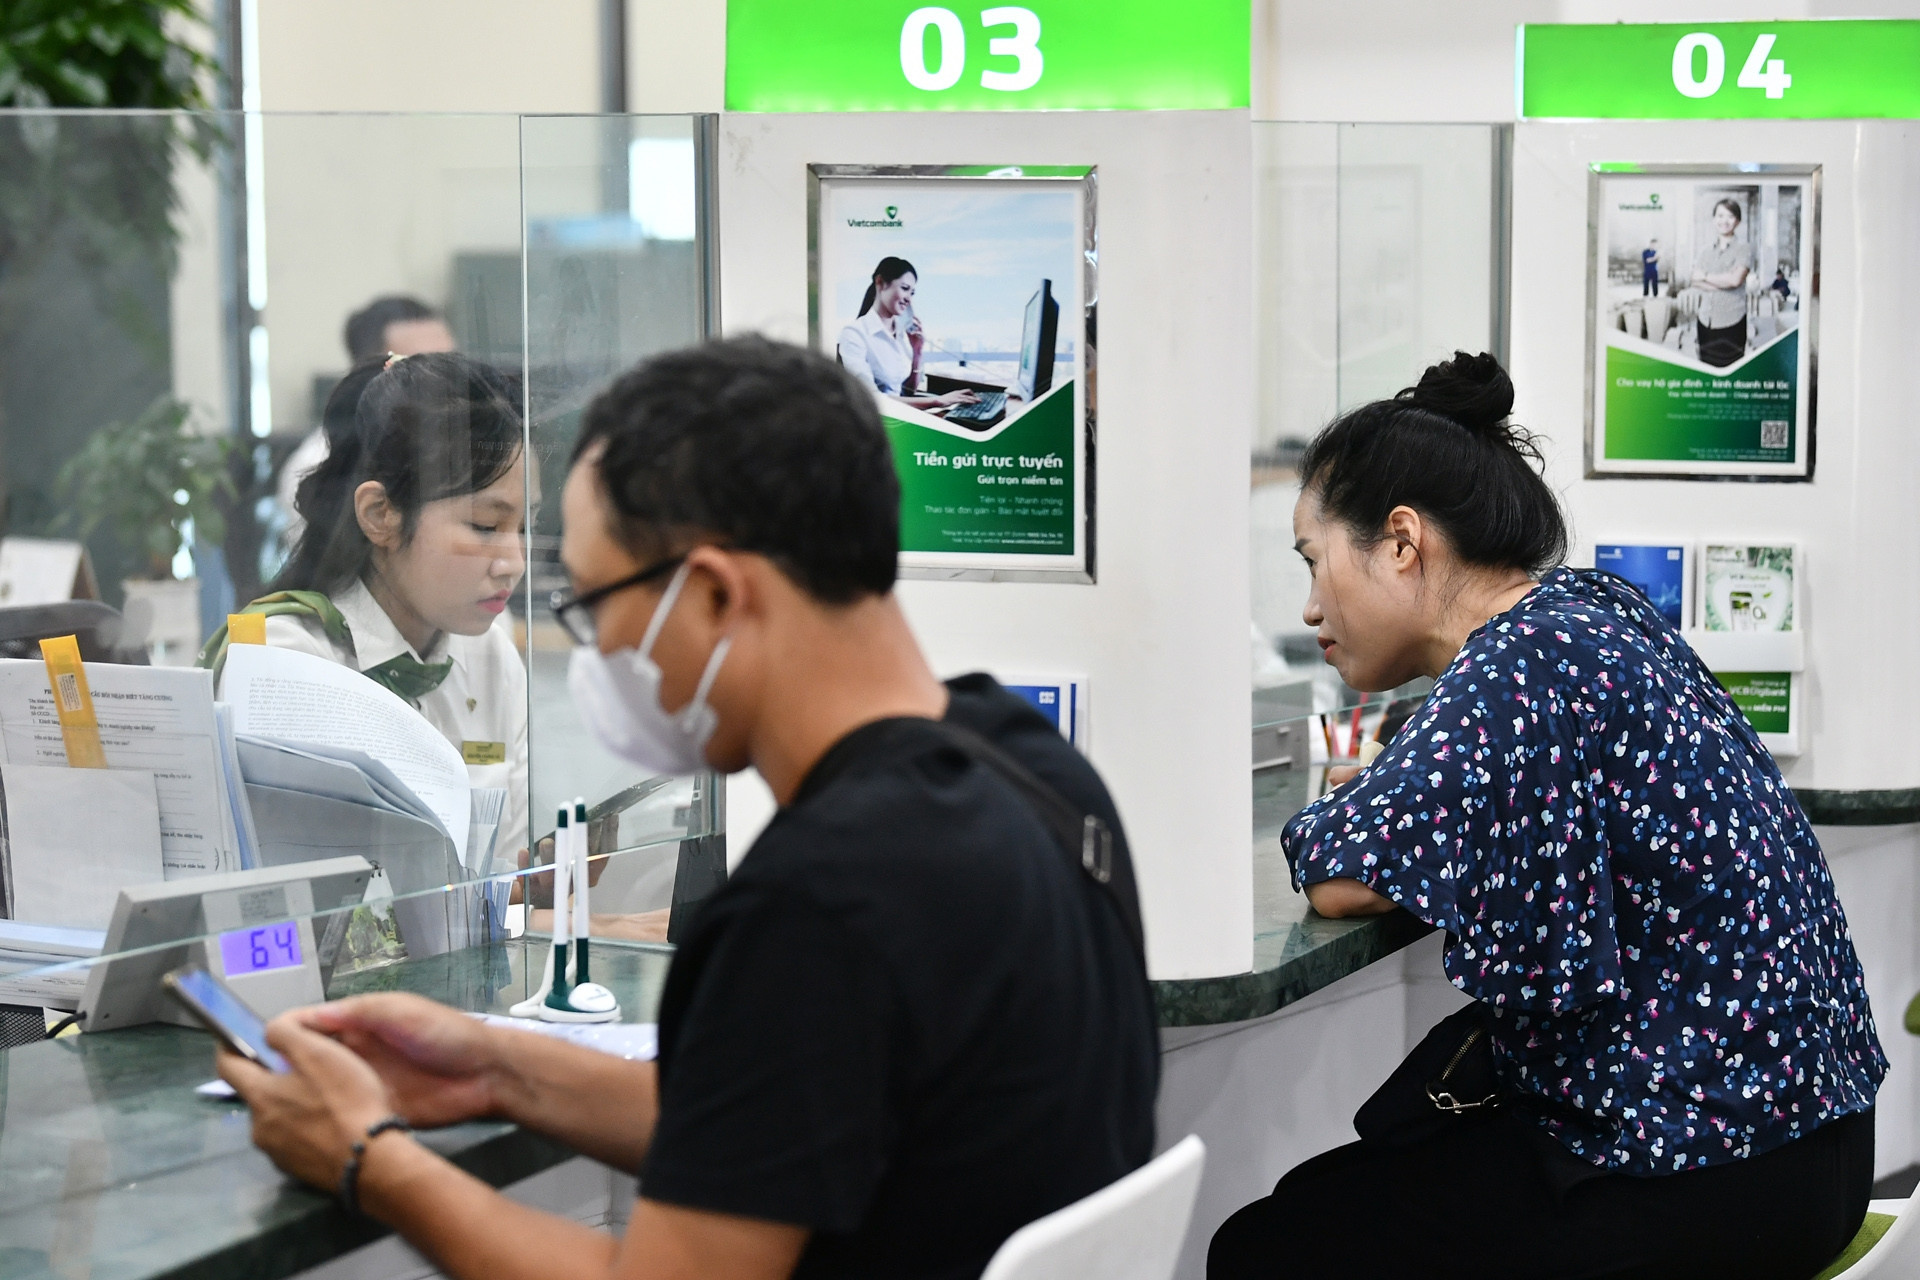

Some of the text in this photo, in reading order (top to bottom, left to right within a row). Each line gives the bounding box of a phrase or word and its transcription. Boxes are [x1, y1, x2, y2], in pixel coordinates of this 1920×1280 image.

[900, 6, 1044, 91] 03
[1672, 32, 1792, 99] 04
[847, 219, 903, 227] Vietcombank
[913, 450, 1063, 470] Tiền gửi trực tuyến
[977, 474, 995, 485] Gửi
[998, 475, 1019, 486] trọn
[1049, 476, 1063, 485] tin
[250, 928, 293, 968] 64
